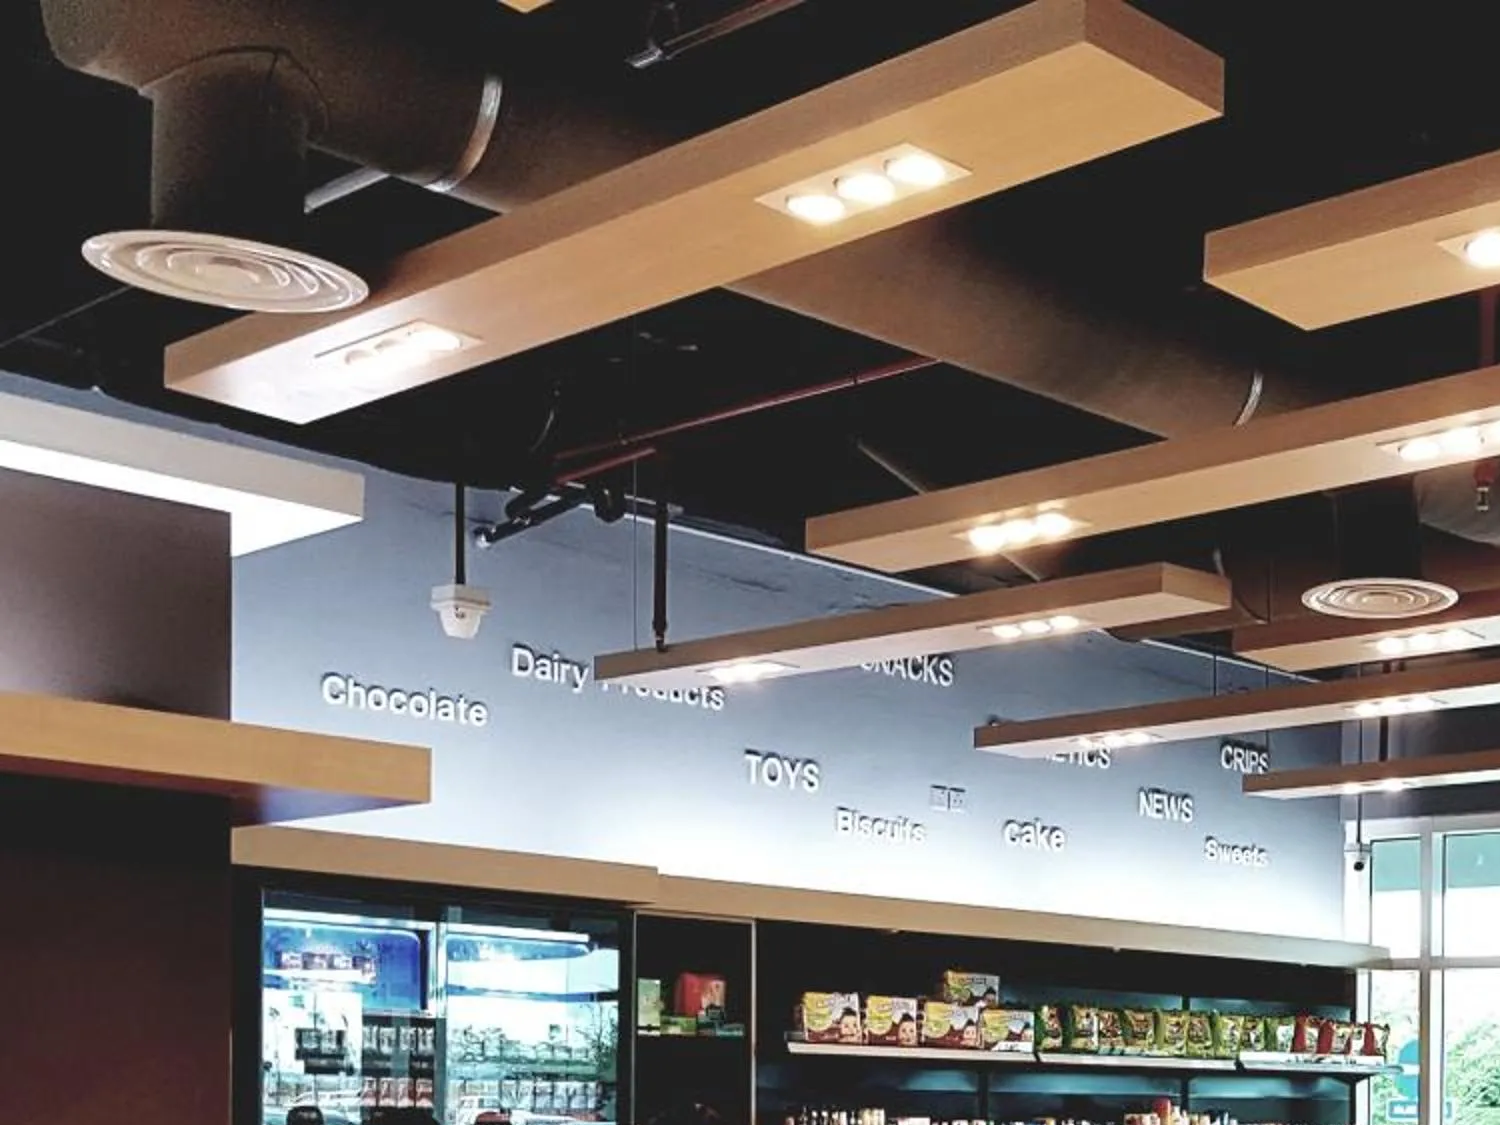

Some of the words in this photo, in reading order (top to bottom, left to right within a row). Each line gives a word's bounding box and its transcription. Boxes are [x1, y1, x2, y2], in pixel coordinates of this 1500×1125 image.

[511, 645, 589, 694] Dairy
[321, 673, 488, 727] Chocolate
[744, 751, 820, 792] TOYS
[1220, 743, 1269, 774] CRIPS
[1138, 788, 1194, 822] NEWS
[837, 807, 926, 844] Biscuits
[1204, 838, 1269, 867] Sweets
